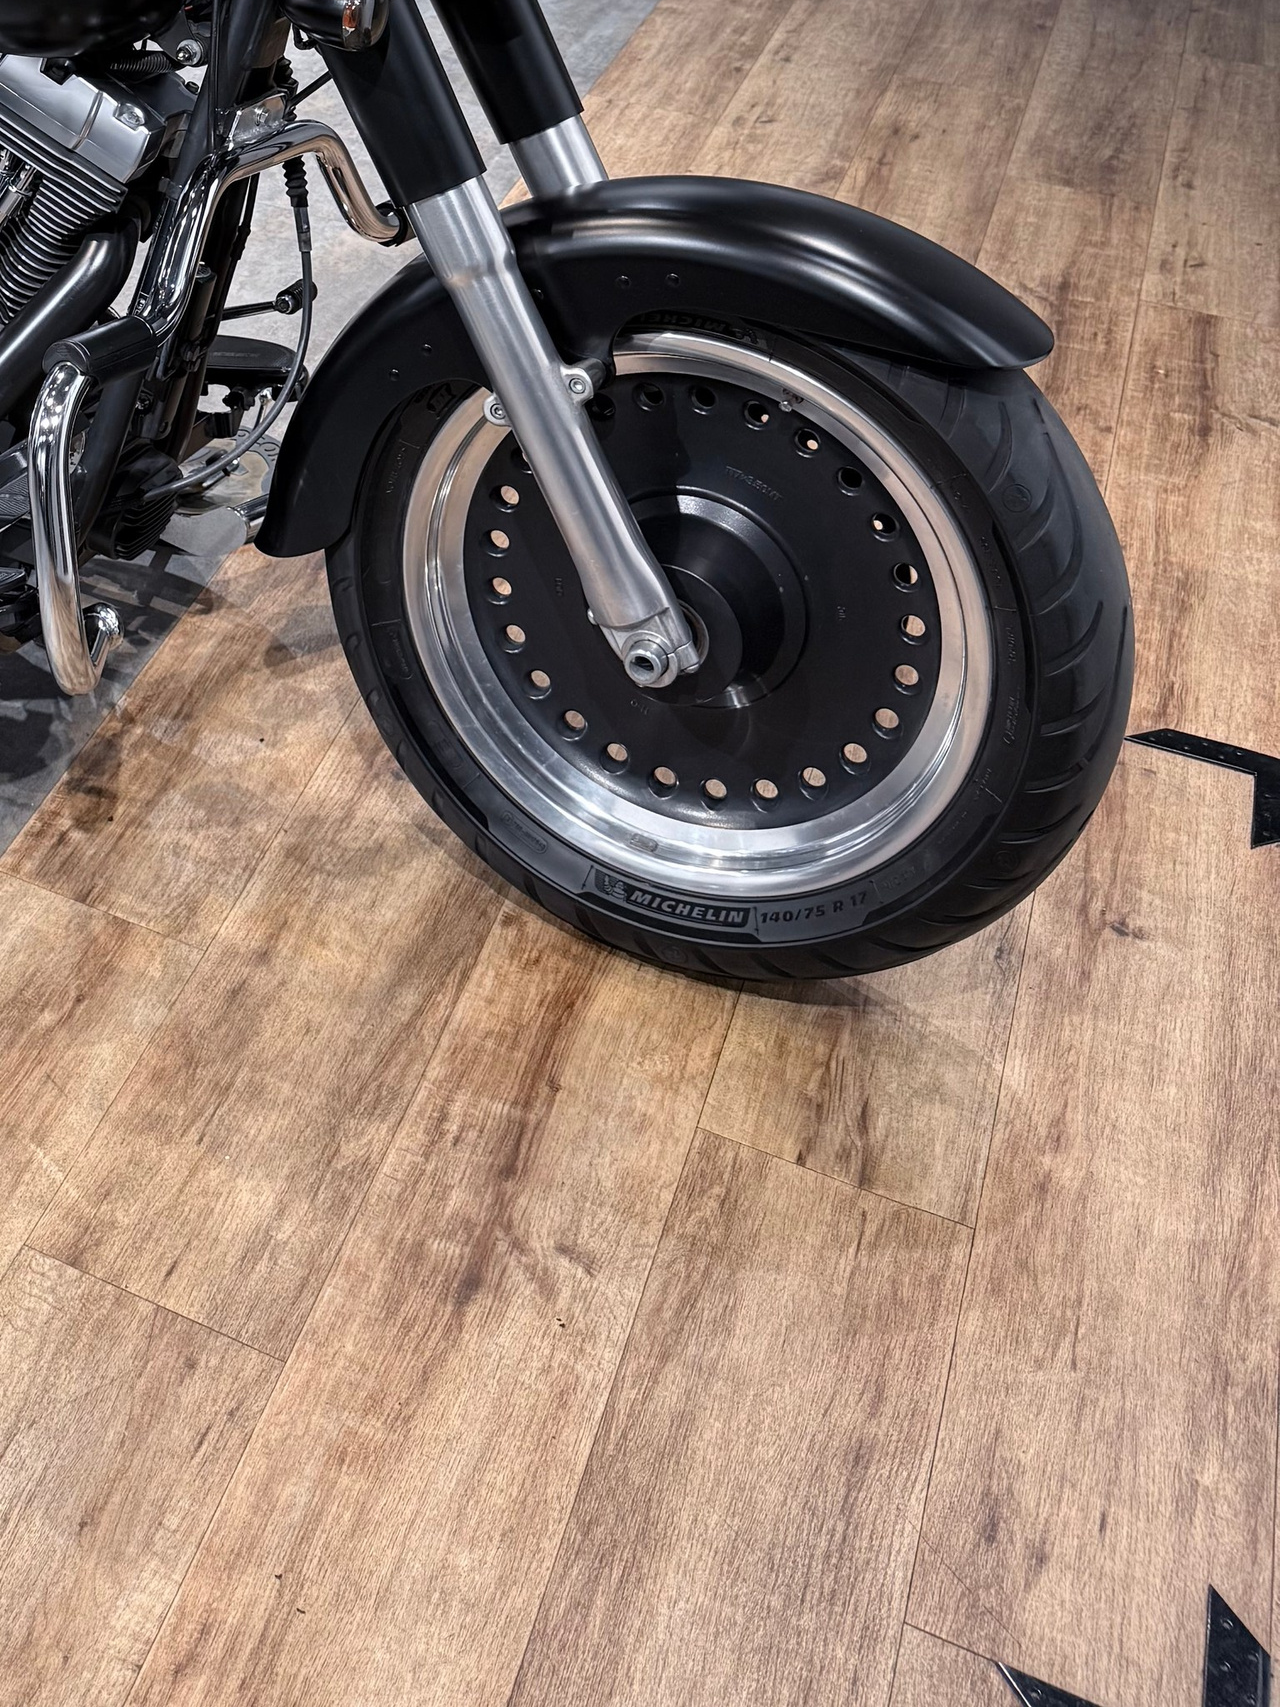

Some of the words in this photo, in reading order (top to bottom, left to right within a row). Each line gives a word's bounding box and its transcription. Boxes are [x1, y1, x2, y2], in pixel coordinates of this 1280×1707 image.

[629, 891, 745, 924] MICHELIN
[760, 905, 825, 924] 140/75
[833, 900, 844, 913] R
[850, 892, 868, 907] 17
